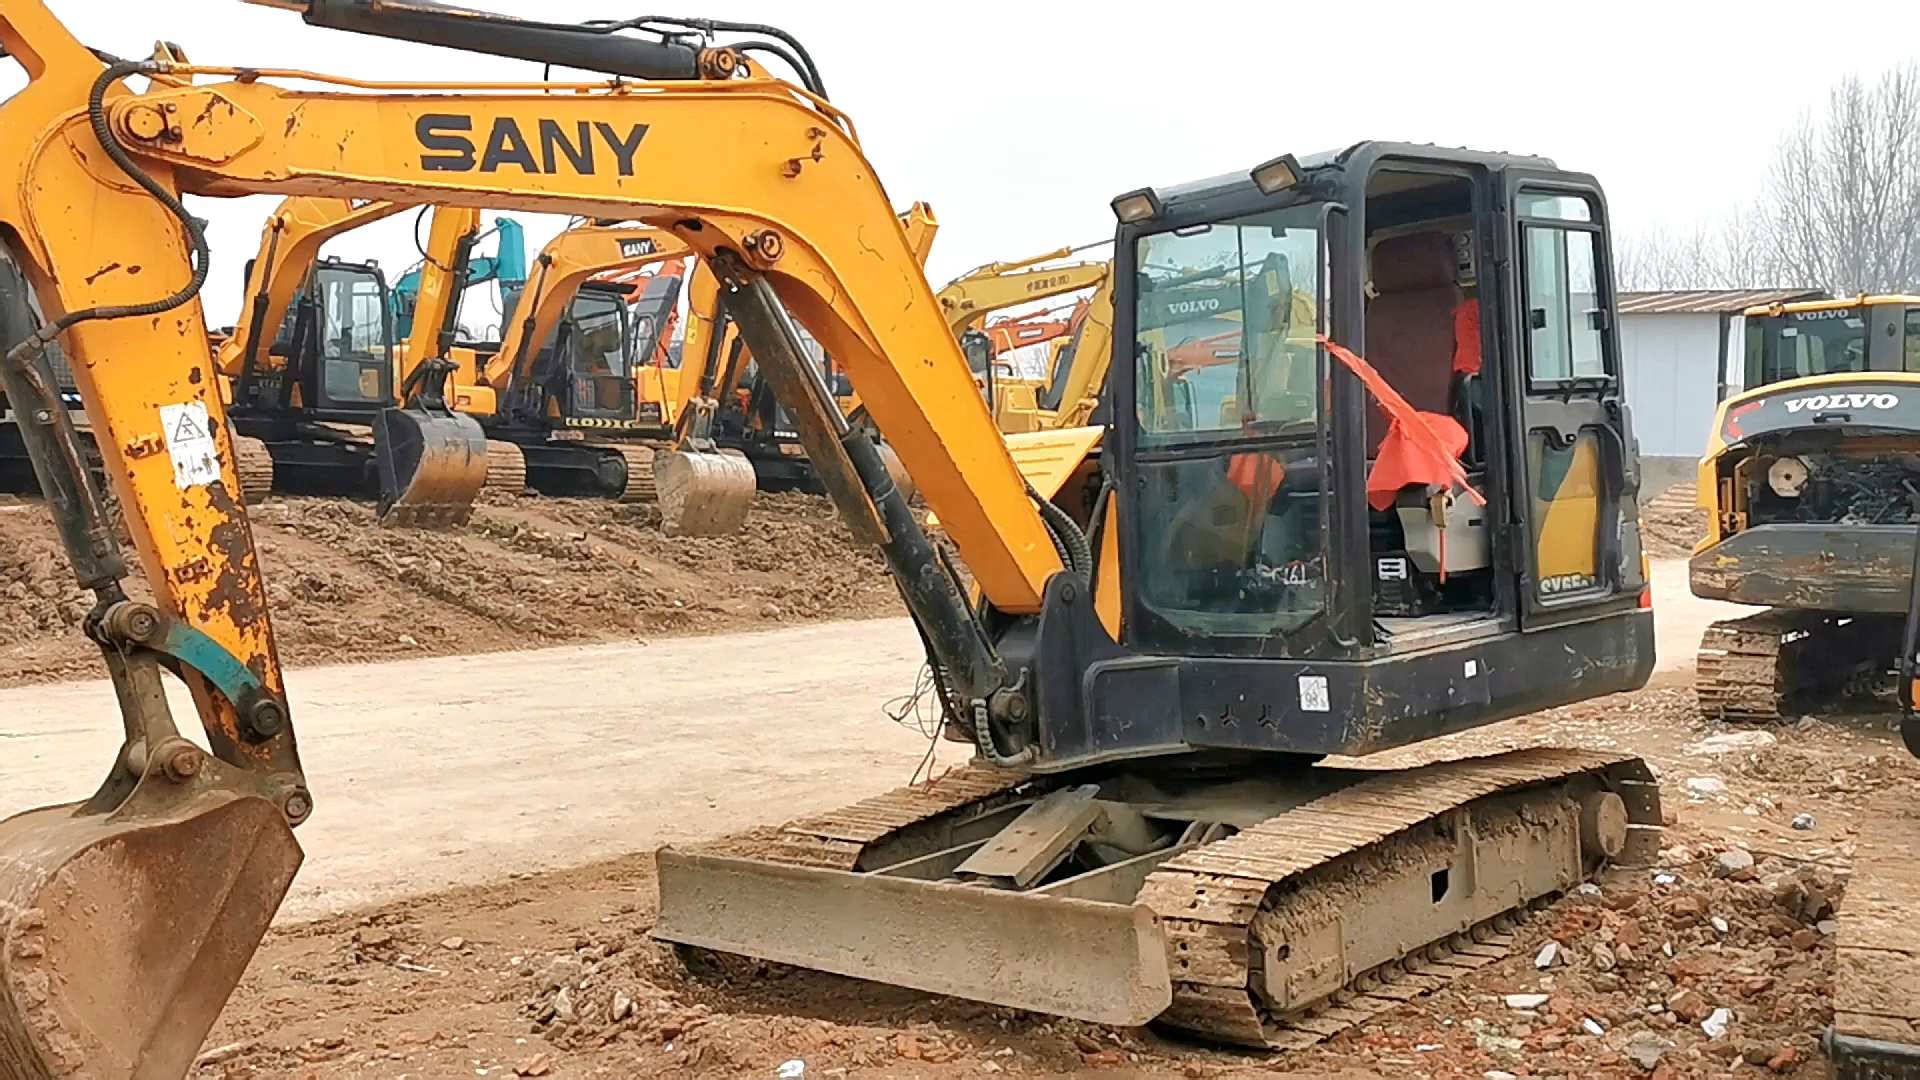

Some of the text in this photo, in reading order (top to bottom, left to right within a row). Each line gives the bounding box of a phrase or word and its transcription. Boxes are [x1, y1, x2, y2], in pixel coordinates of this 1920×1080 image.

[415, 113, 650, 176] SANY
[624, 240, 651, 257] SANY
[1167, 298, 1219, 315] VOLVO
[1795, 308, 1849, 321] VOLVO
[1784, 394, 1899, 413] VOLVO
